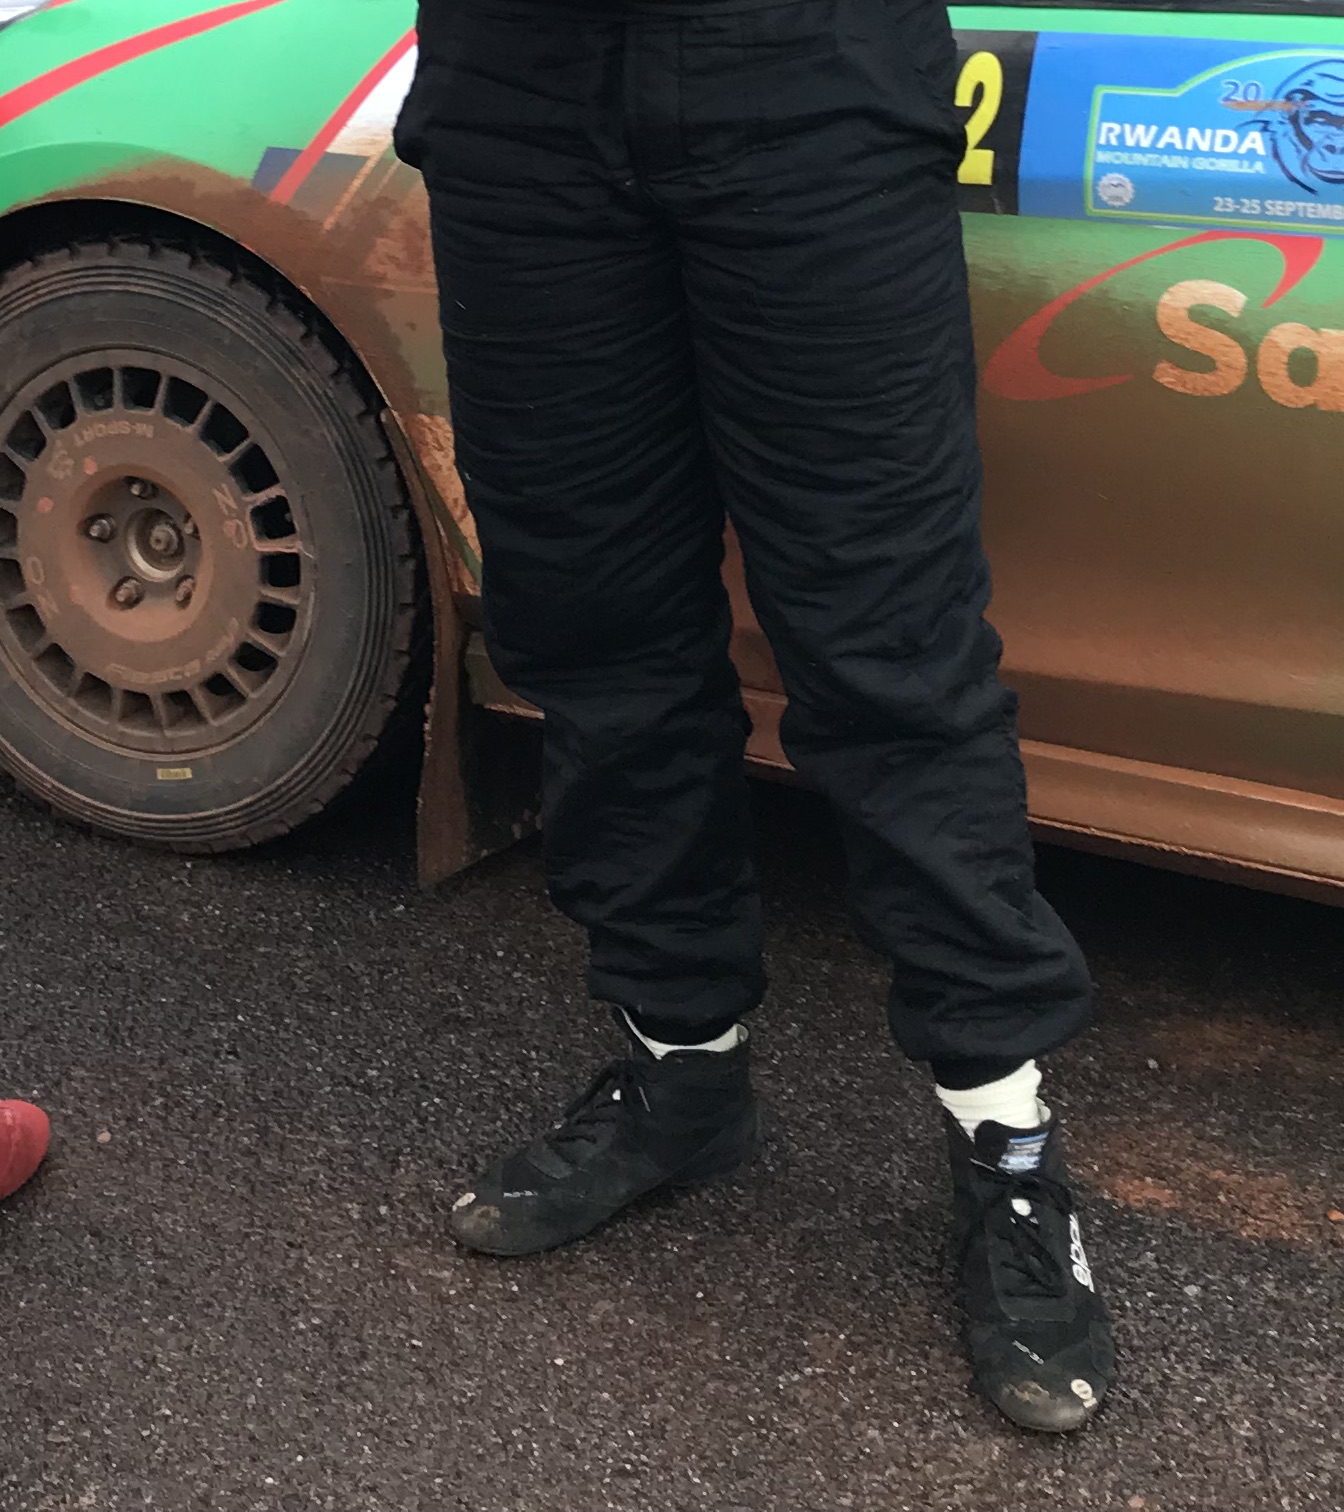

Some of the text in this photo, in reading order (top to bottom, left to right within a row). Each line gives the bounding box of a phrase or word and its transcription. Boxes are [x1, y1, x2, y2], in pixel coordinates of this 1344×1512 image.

[1221, 80, 1262, 103] 20
[954, 51, 1003, 185] 2
[1098, 122, 1267, 156] RWANDA
[1096, 150, 1266, 174] MOUNTAIN GORILLA
[1213, 196, 1262, 215] 23-25
